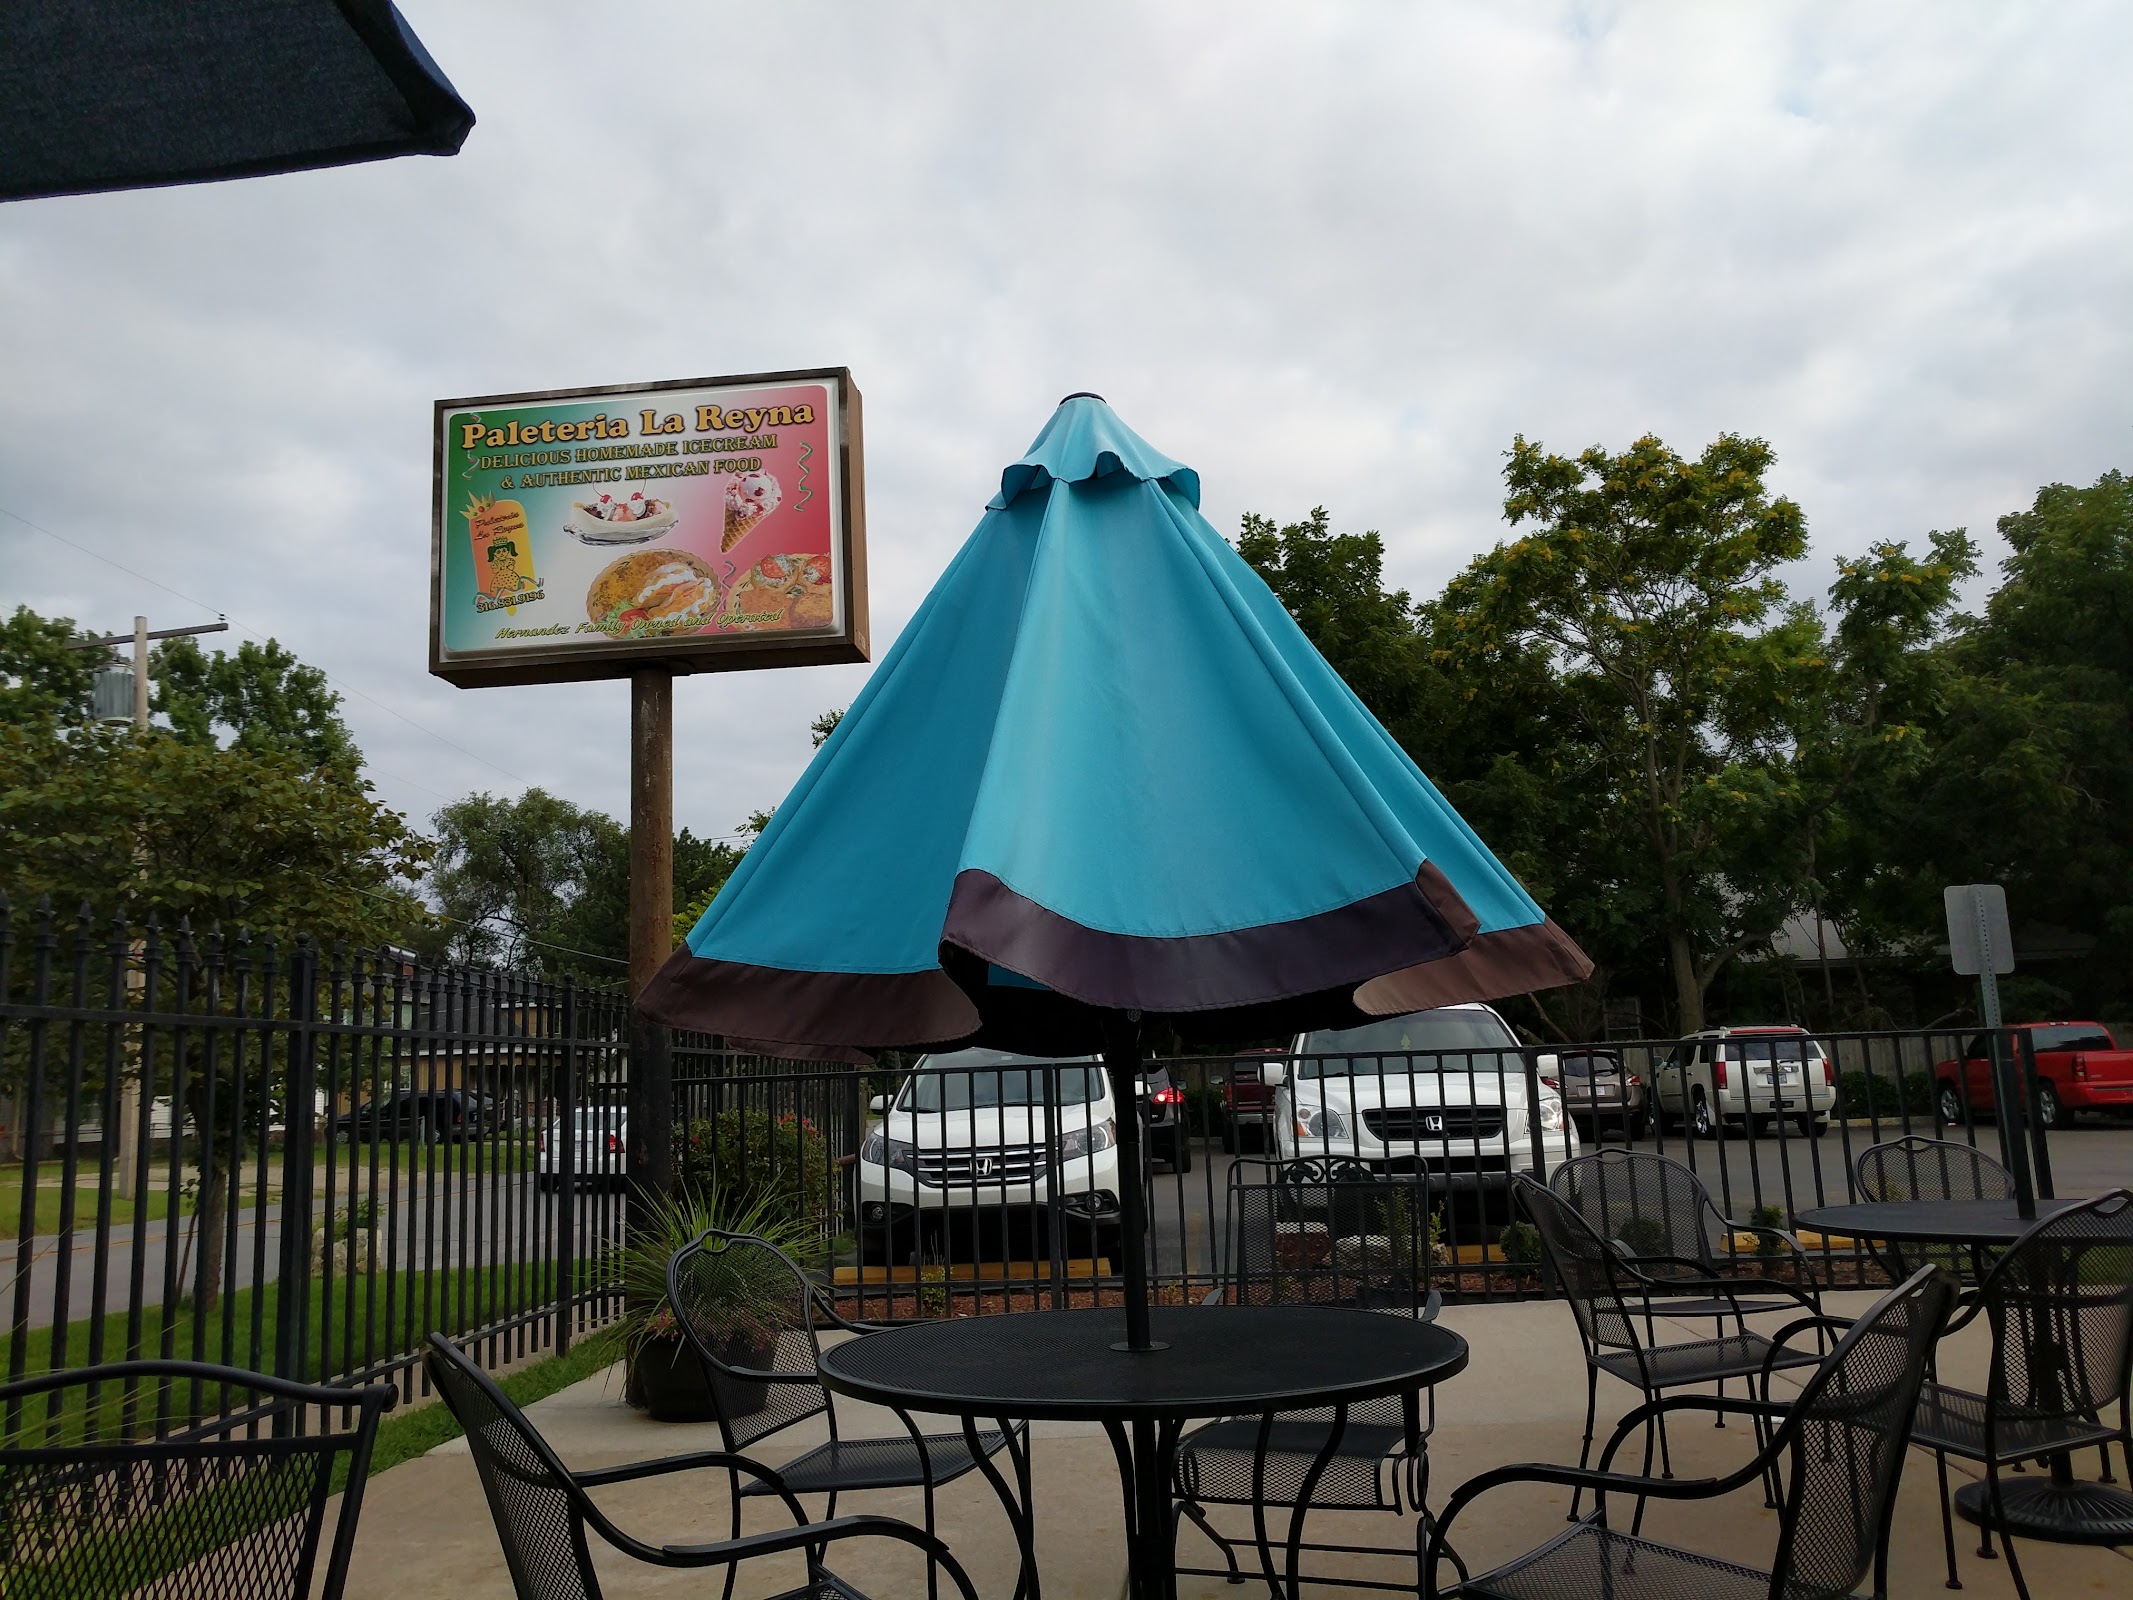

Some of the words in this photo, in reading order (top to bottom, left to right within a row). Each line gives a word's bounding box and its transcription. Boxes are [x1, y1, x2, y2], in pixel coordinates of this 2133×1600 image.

[461, 414, 629, 449] Paleteria
[640, 408, 685, 436] La
[695, 403, 815, 433] Reyna
[480, 449, 571, 470] DELICIOUS
[575, 441, 678, 463] HOMEMADE
[682, 434, 778, 454] ICECREAM
[501, 475, 515, 489] &
[520, 466, 622, 489] AUTHENTIC
[625, 459, 709, 482] MEXICAN
[713, 457, 762, 474] FOOD
[495, 622, 570, 640] Hernandez
[575, 619, 626, 636] Family
[630, 614, 681, 631] Owned
[683, 612, 715, 628] and
[717, 608, 785, 631] Operated
